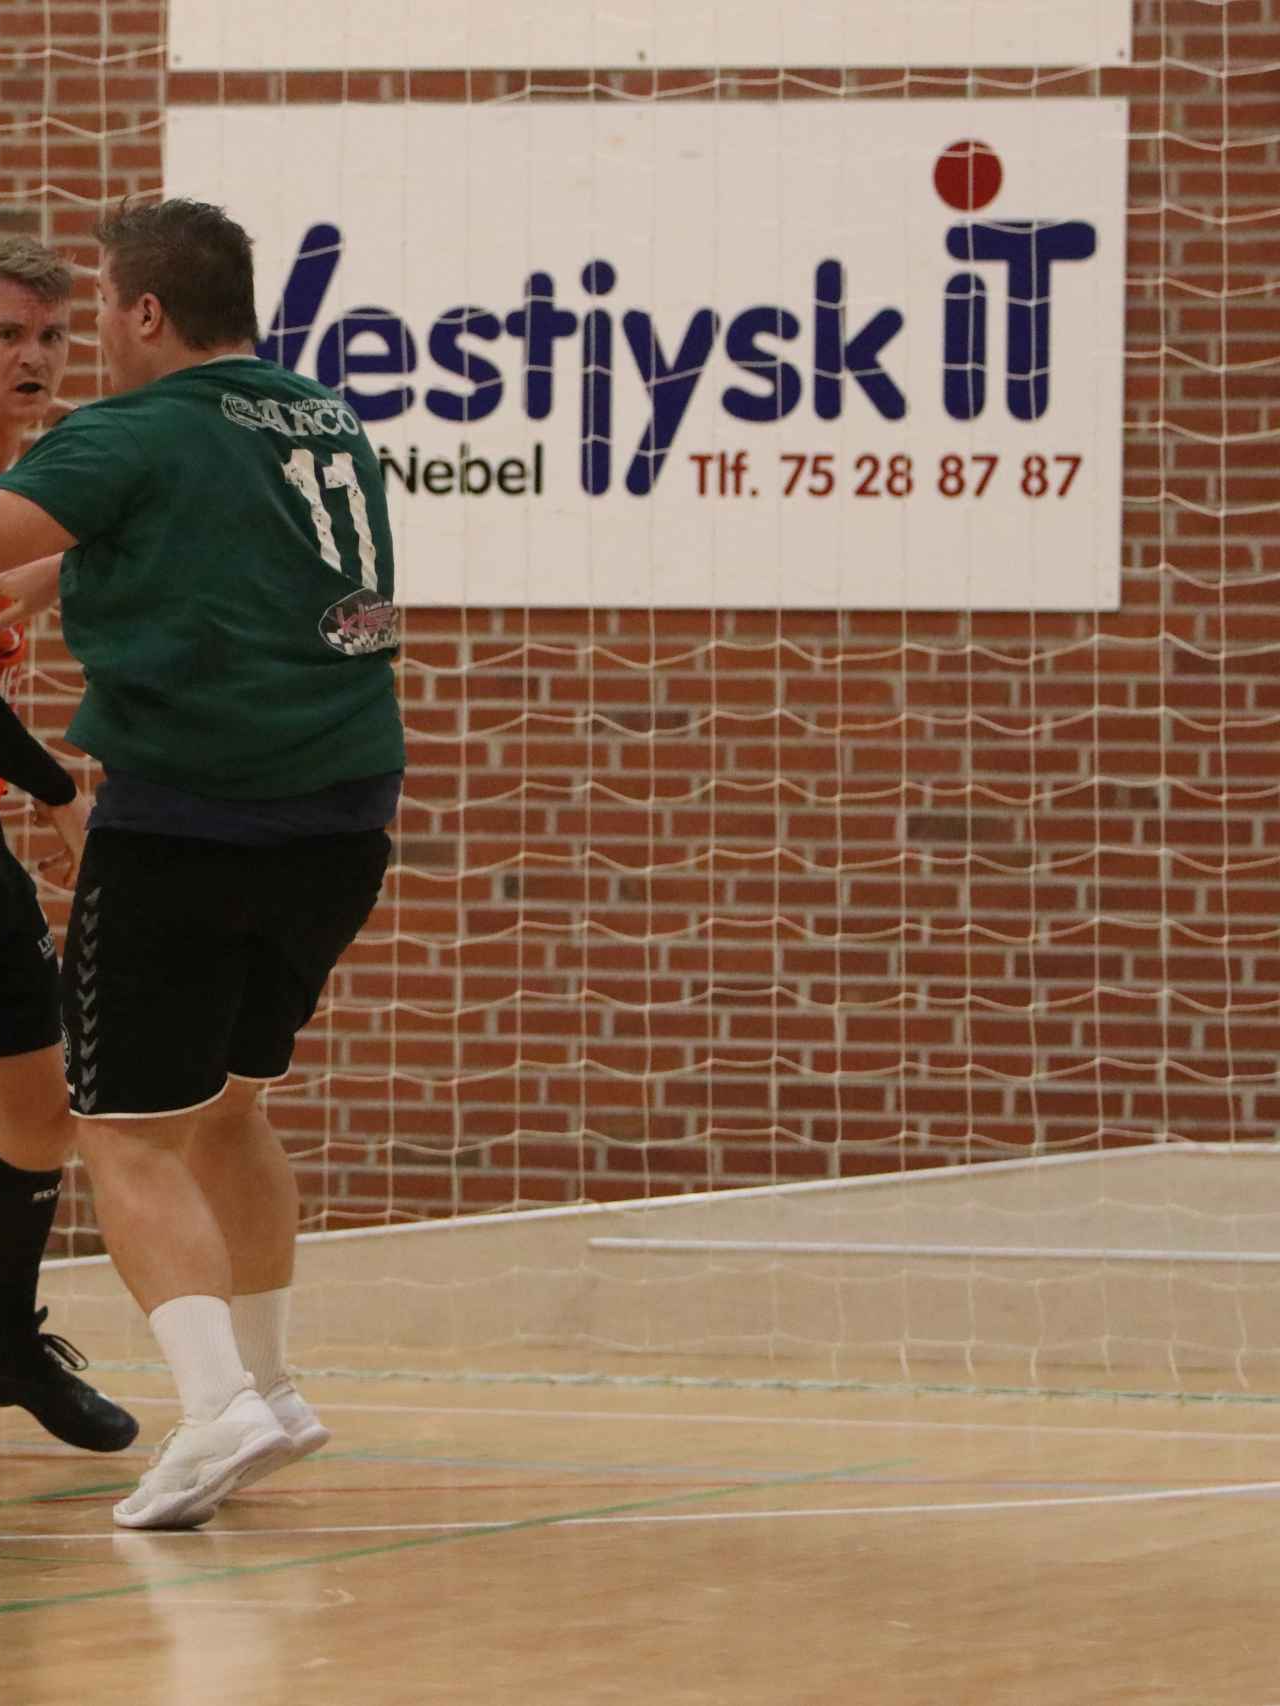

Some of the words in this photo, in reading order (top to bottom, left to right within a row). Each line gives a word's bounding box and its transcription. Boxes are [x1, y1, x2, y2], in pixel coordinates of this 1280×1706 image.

[380, 443, 543, 496] Nebel
[689, 449, 758, 497] Tlf.
[780, 454, 835, 497] 75
[854, 454, 913, 497] 28
[937, 454, 999, 497] 87
[1021, 454, 1082, 497] 87
[280, 448, 378, 592] 11
